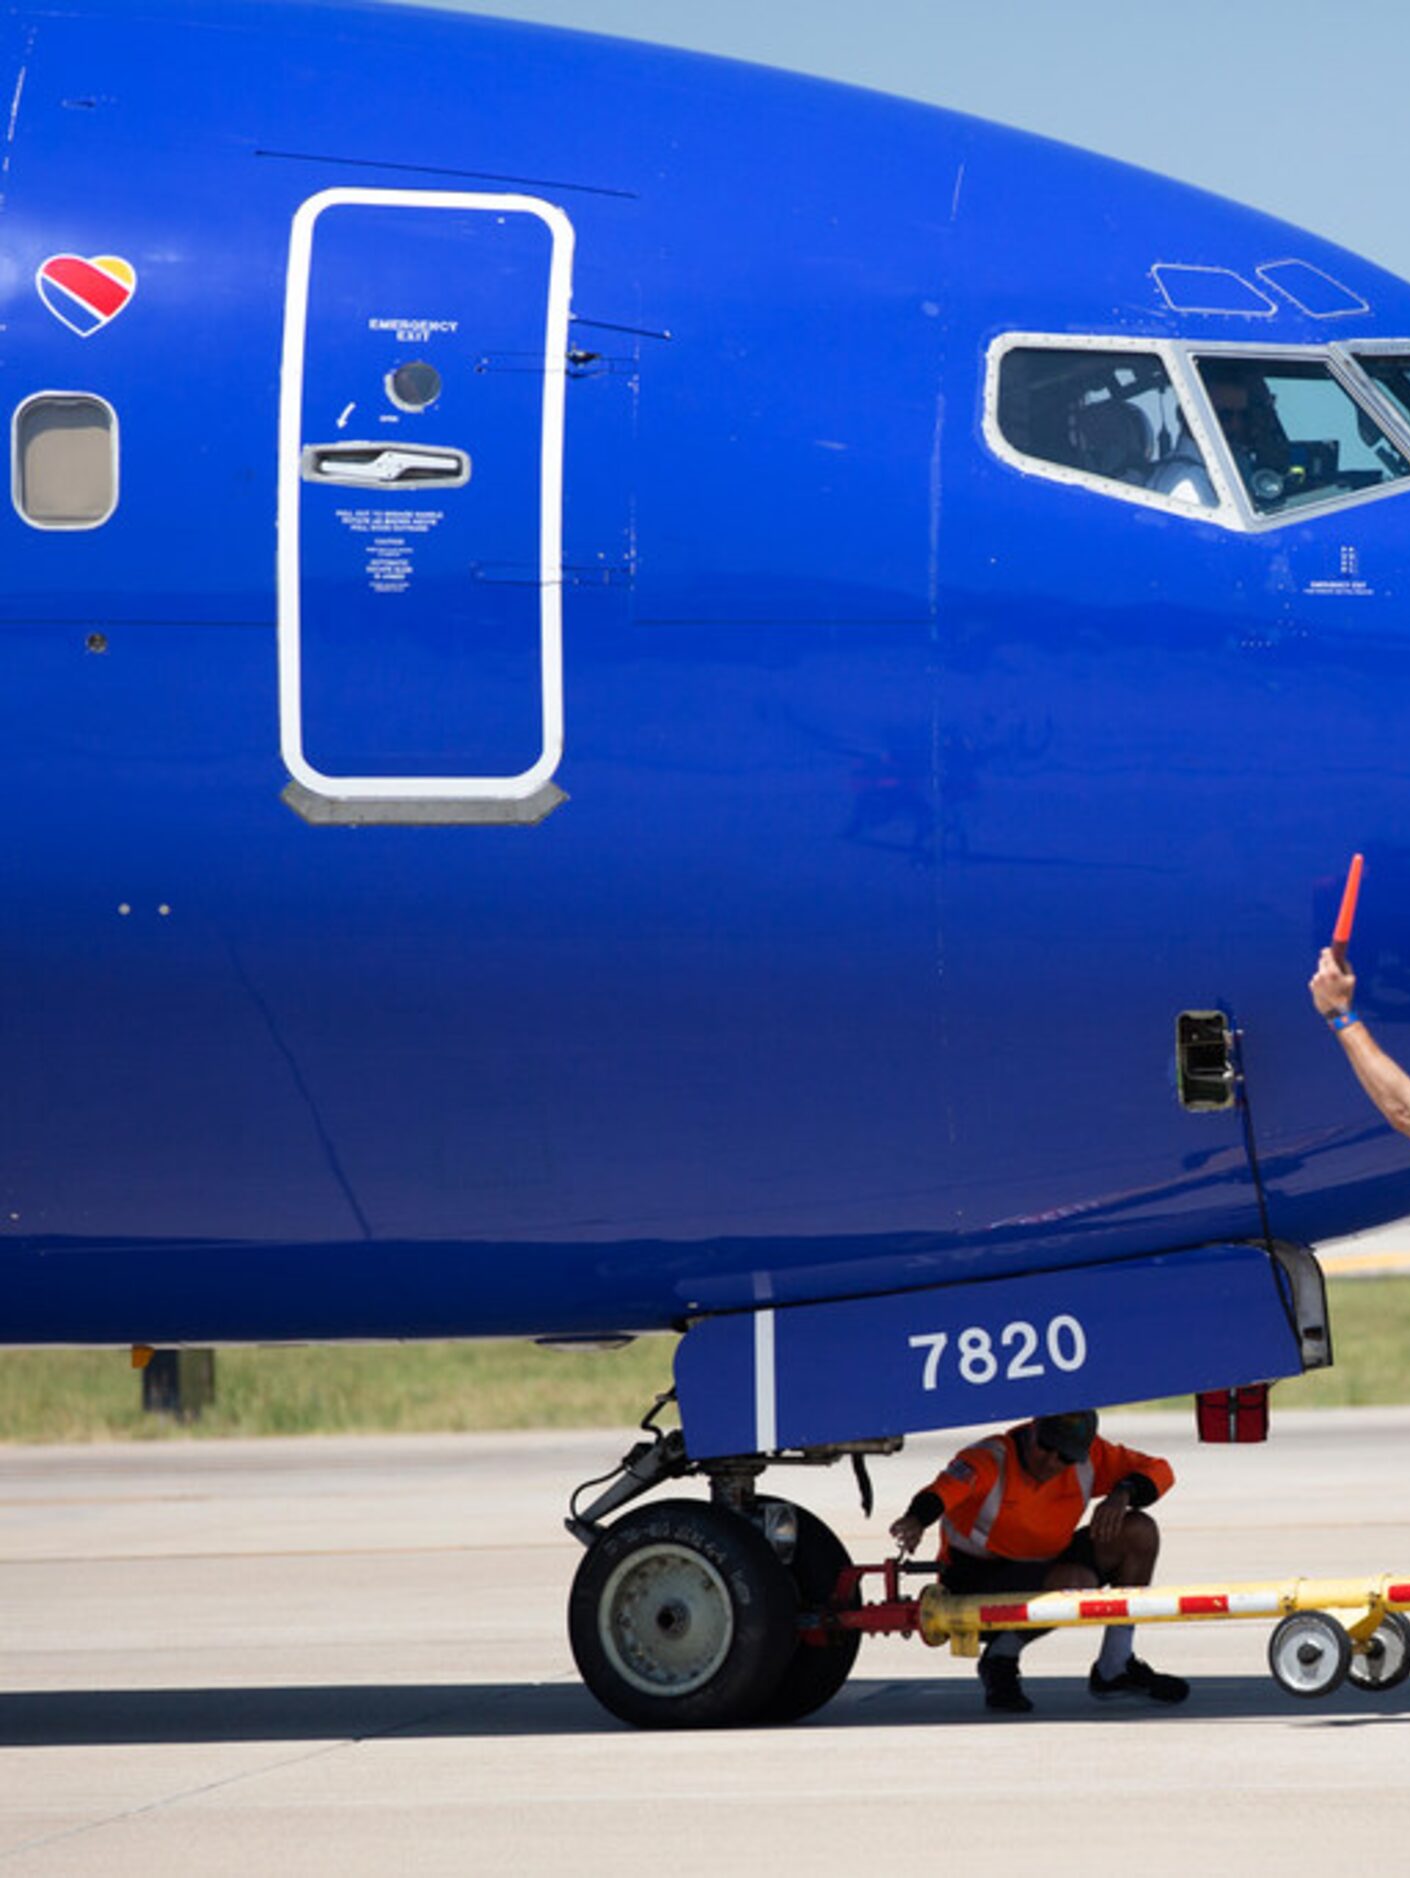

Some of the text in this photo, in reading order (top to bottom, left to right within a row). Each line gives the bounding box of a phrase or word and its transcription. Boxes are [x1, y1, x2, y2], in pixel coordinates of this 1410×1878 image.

[368, 319, 458, 331] EMERGENCY
[396, 330, 429, 341] EXIT
[908, 1314, 1087, 1391] 7820
